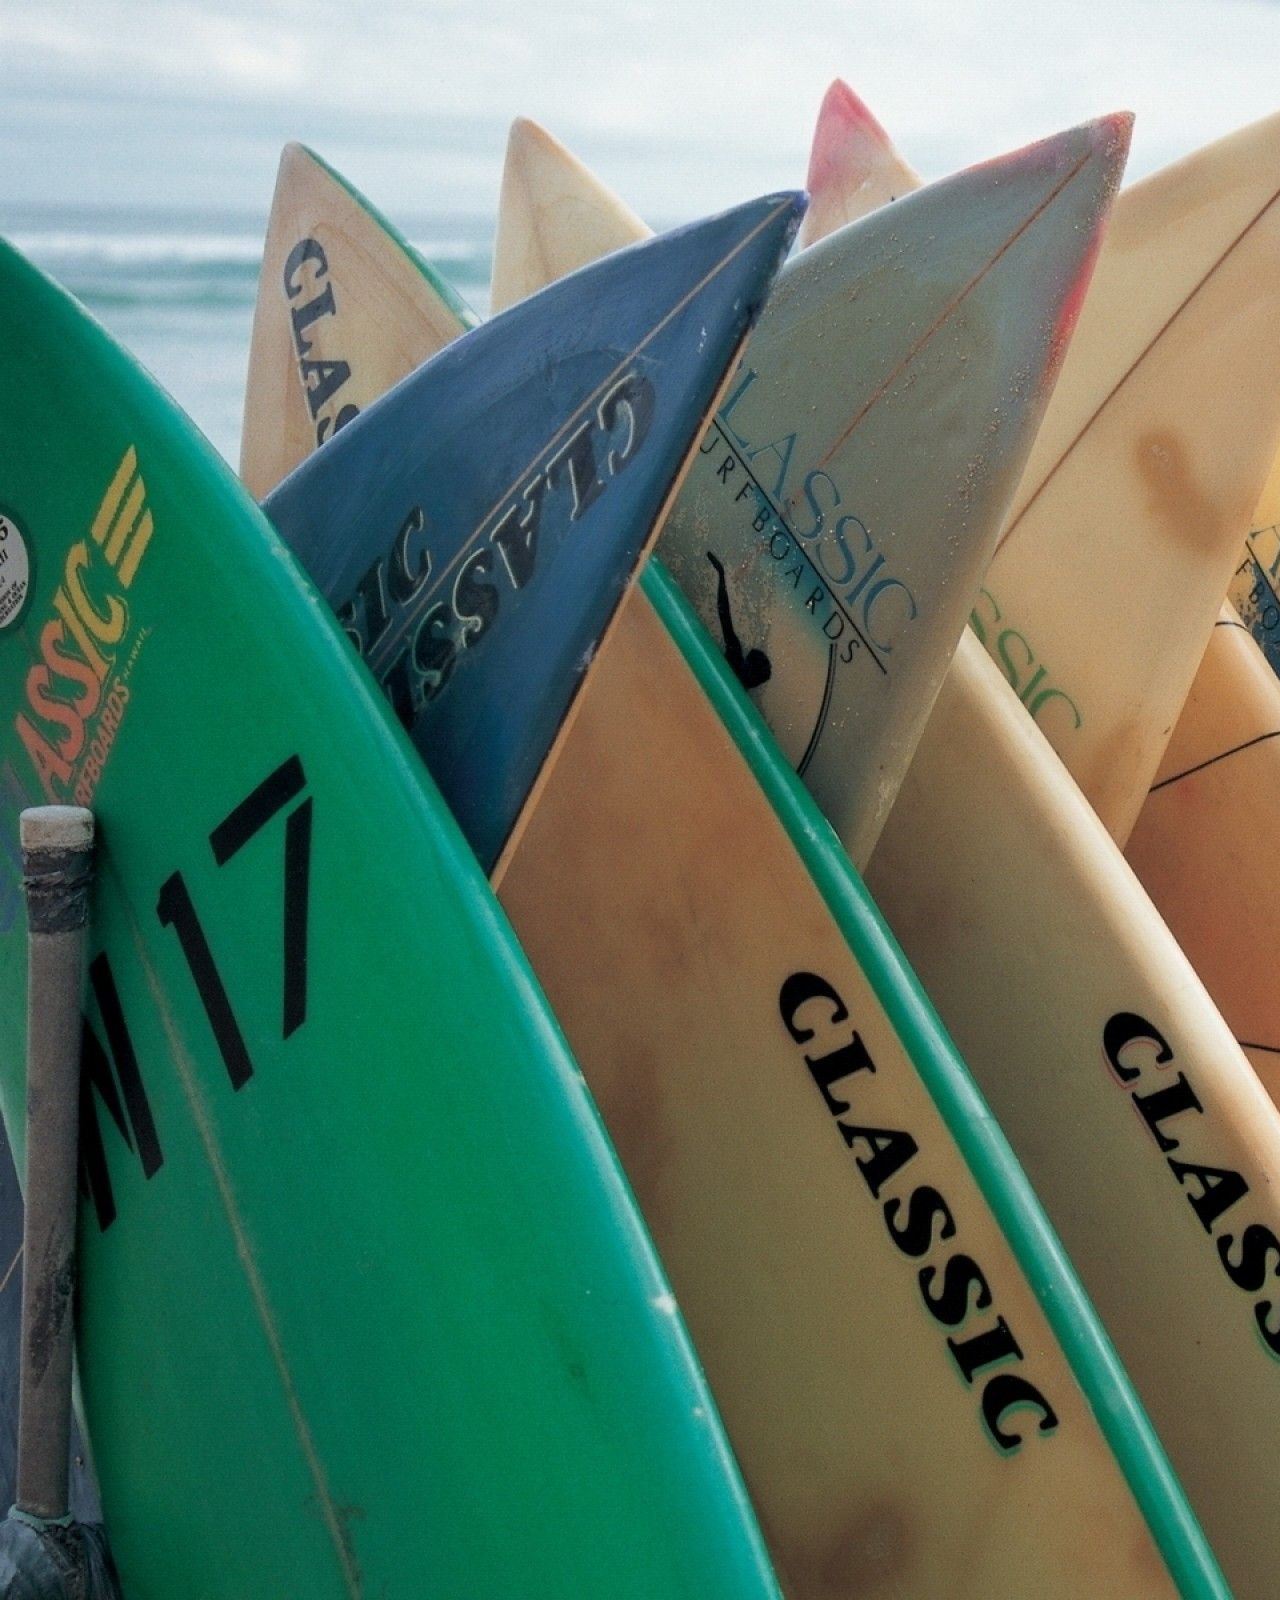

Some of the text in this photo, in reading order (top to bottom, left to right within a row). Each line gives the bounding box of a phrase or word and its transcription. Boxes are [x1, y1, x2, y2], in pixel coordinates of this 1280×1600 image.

[718, 360, 918, 654] LASSIC
[16, 538, 130, 804] ASSIC
[155, 753, 314, 1093] 17
[778, 970, 1059, 1457] CLASSIC
